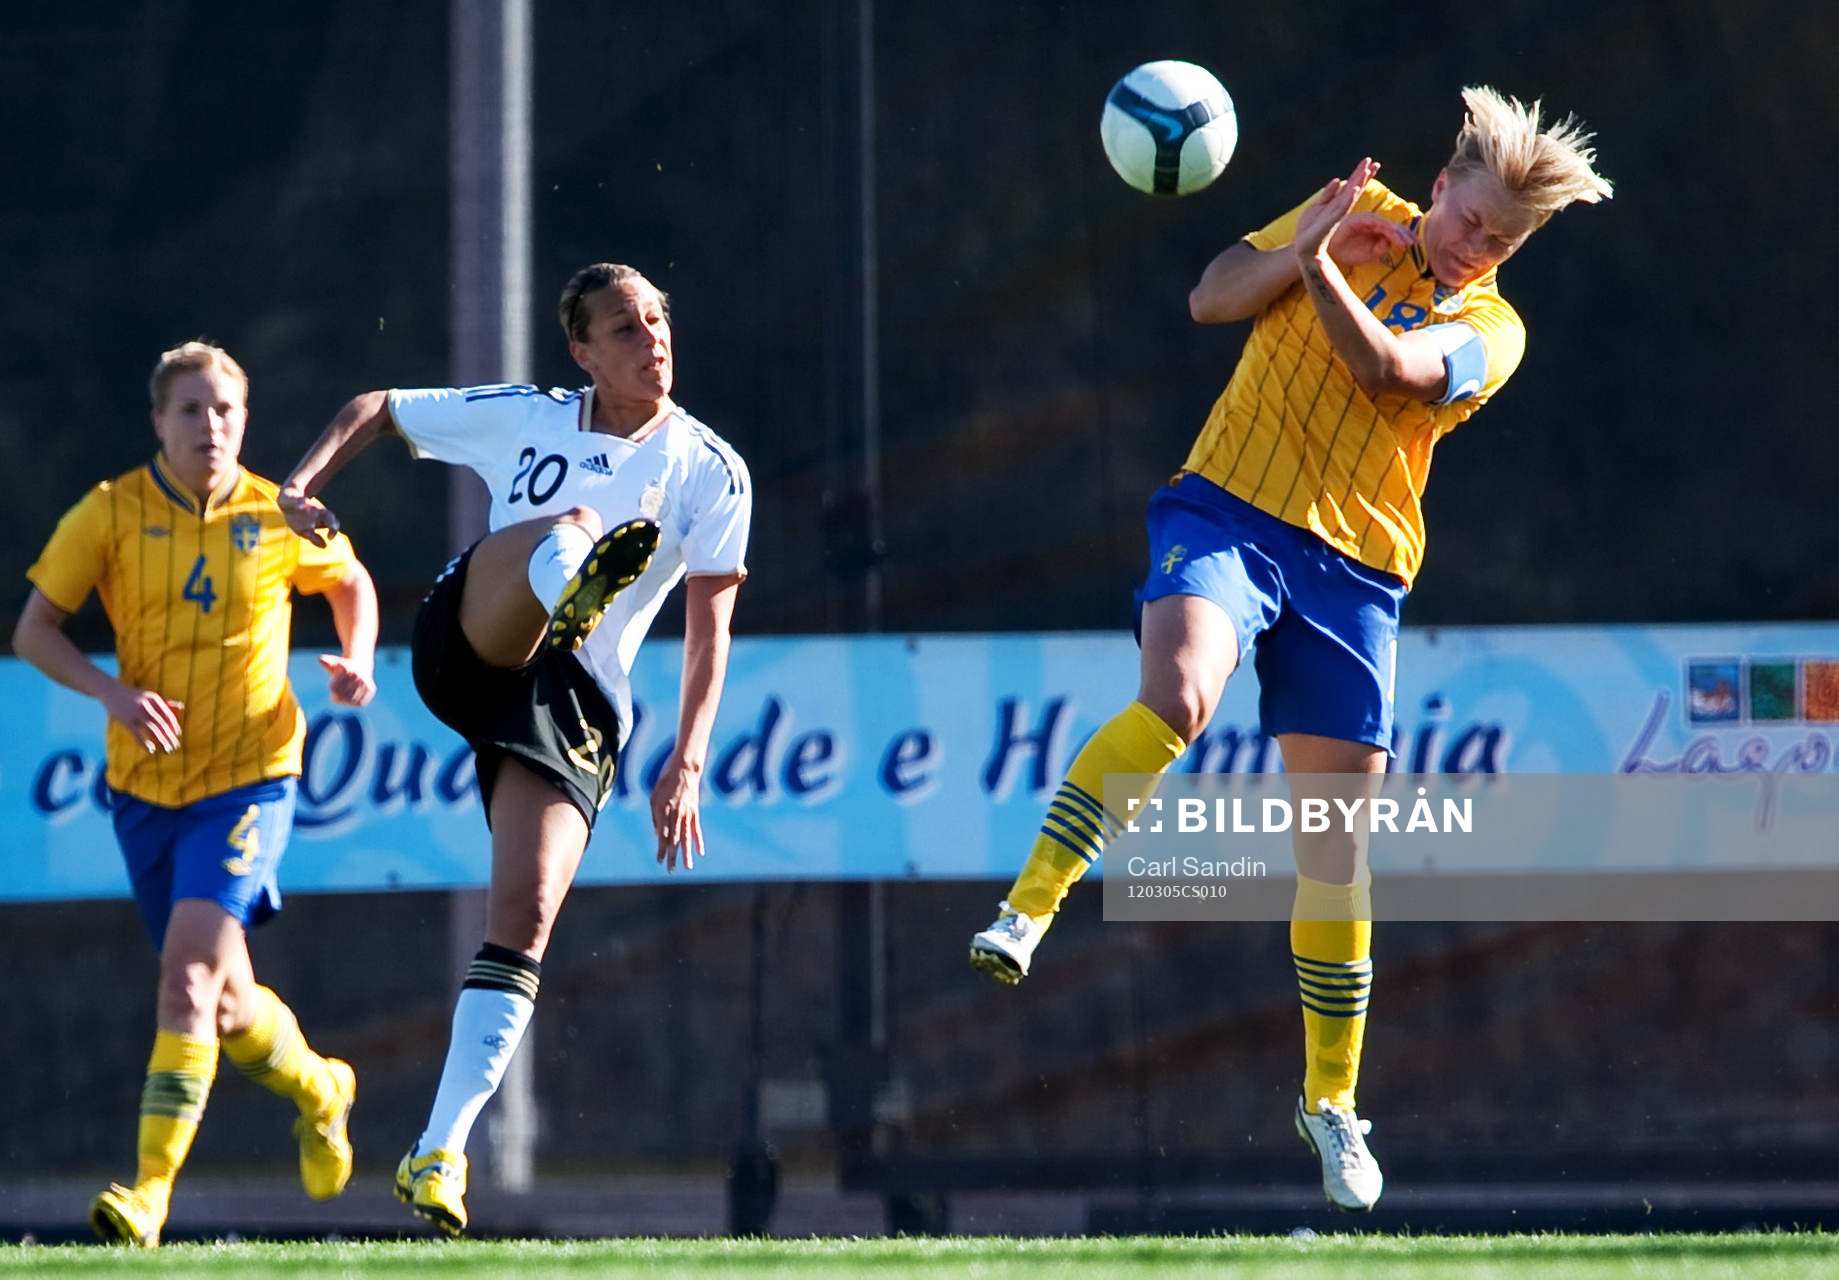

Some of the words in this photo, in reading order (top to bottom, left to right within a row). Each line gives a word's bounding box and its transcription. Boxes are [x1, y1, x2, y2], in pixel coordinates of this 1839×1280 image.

[508, 446, 569, 506] 20
[182, 553, 217, 614] 4
[877, 728, 934, 798] e
[1618, 688, 1839, 834] Lago
[227, 803, 261, 864] 4
